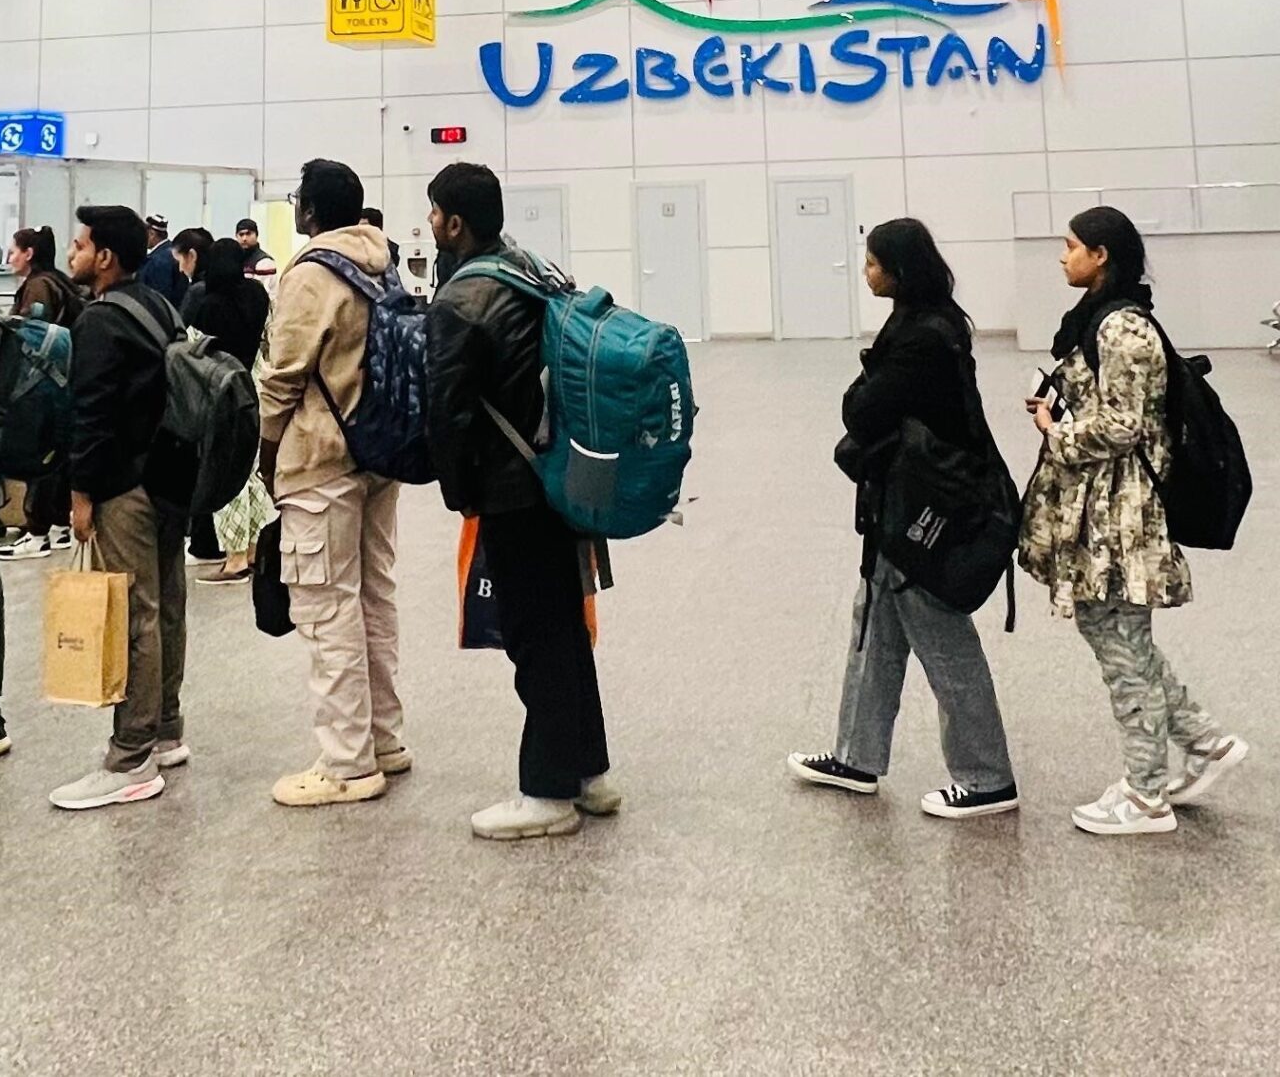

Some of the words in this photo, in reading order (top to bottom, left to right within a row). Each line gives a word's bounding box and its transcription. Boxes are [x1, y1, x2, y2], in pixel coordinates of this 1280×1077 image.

[346, 17, 389, 27] TOILETS
[479, 23, 1046, 107] UZBEKISTAN
[670, 382, 682, 441] SAFARI
